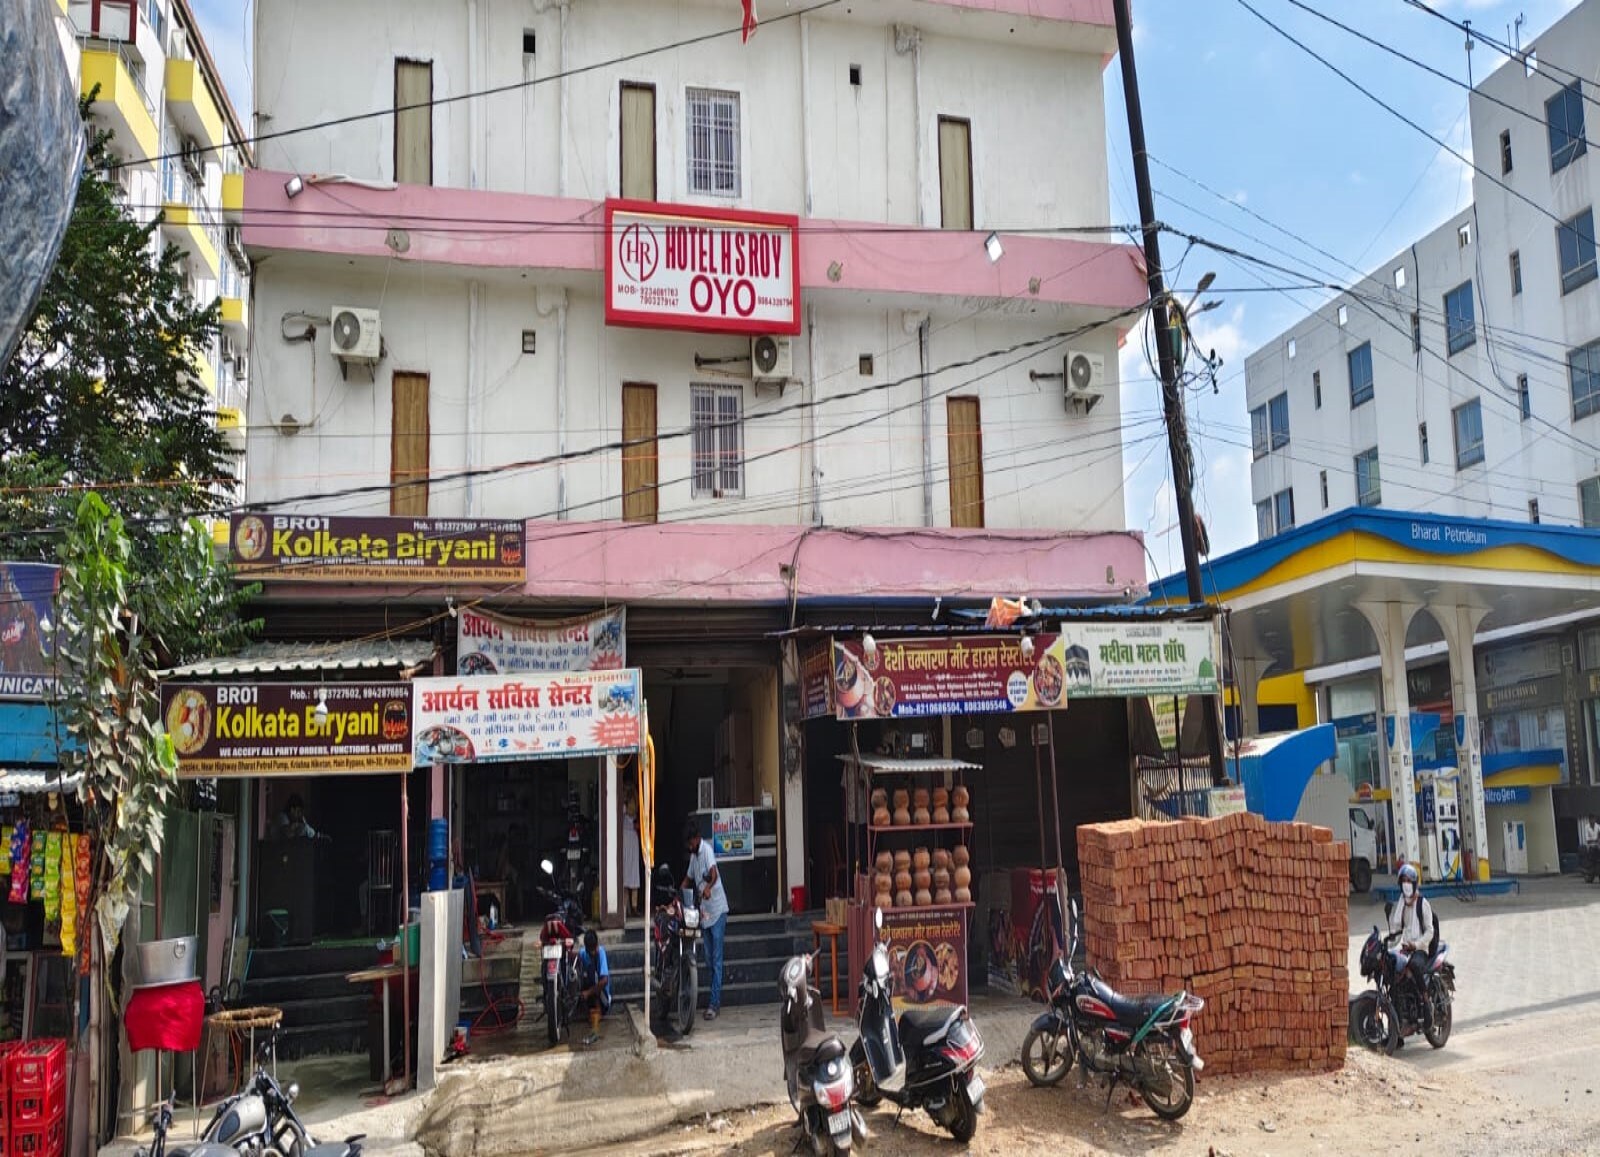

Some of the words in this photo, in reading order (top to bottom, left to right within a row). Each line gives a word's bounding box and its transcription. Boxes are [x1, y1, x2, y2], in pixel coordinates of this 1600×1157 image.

[665, 226, 717, 273] HOTEL
[749, 233, 781, 279] ROY
[690, 274, 756, 317] OYO
[273, 516, 330, 530] BR01
[1411, 523, 1441, 541] Bharat
[1444, 526, 1487, 545] Petroleum
[272, 529, 389, 559] Kolkata
[396, 531, 496, 566] Biryani
[884, 643, 905, 671] देशी
[906, 649, 949, 671] चम्पारण
[950, 642, 970, 670] मीट
[971, 646, 998, 669] हाउस
[1099, 639, 1134, 664] मदीना
[1136, 643, 1161, 663] मटन
[1163, 638, 1186, 662] शॉप
[216, 686, 258, 704] BR01
[422, 684, 479, 713] आर्यन
[487, 682, 541, 710] सर्विस
[547, 681, 593, 706] सेन्टर
[216, 705, 300, 739] Kolkata
[219, 747, 232, 756] WE
[275, 746, 298, 756] PARTY
[377, 743, 403, 753] EVENTS
